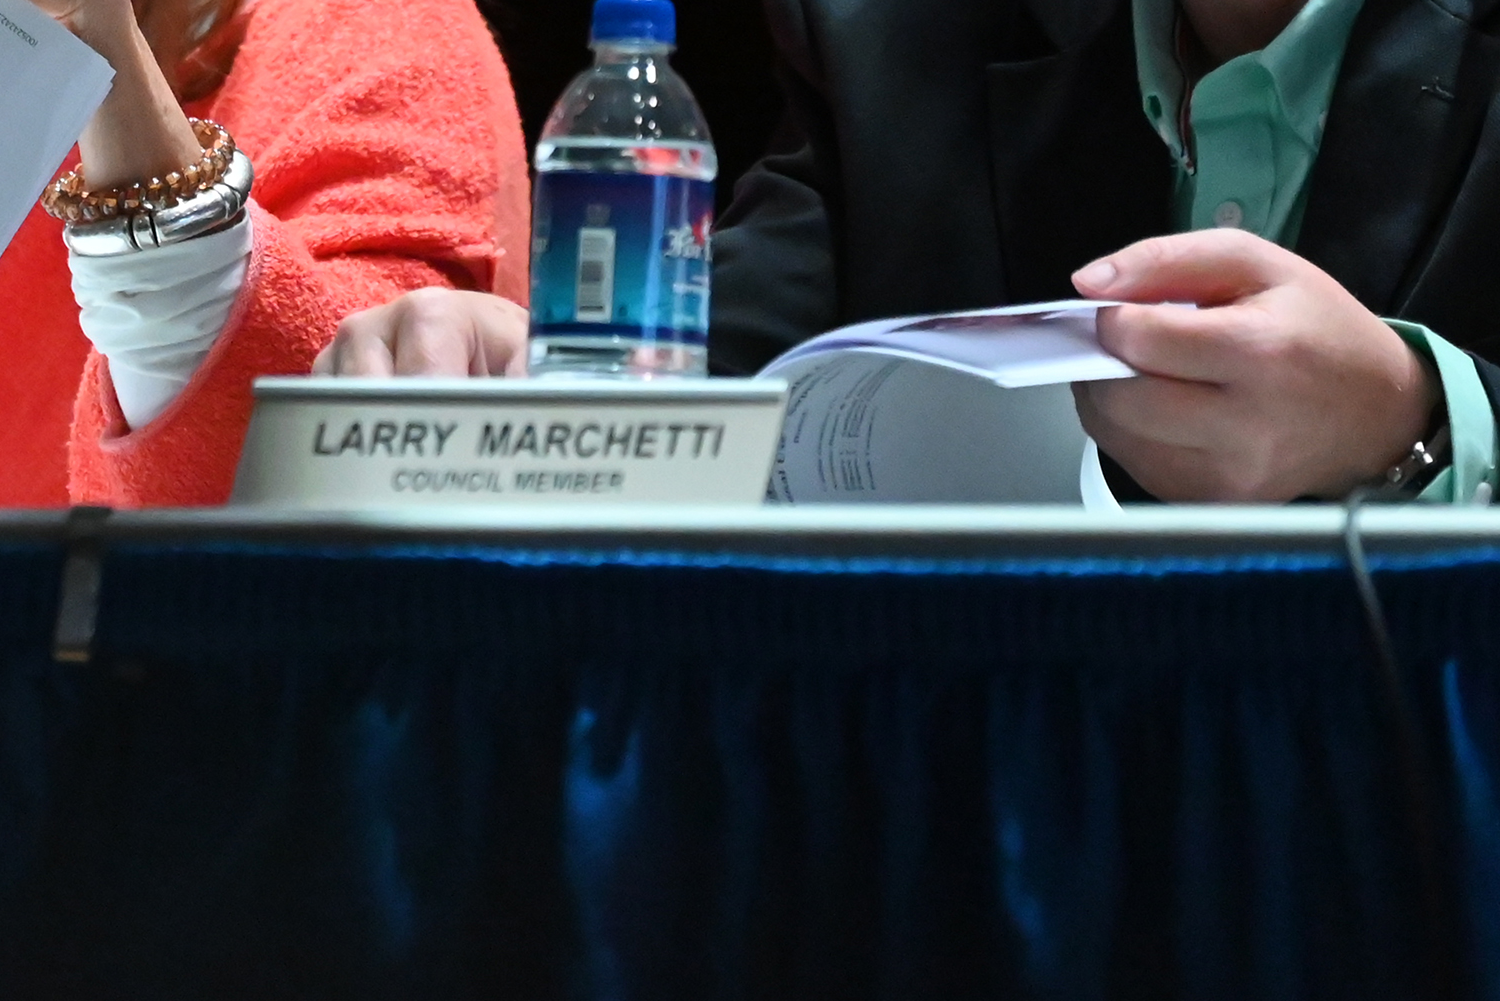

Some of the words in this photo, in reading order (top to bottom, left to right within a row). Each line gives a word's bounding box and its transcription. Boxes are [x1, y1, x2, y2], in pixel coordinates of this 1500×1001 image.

[313, 422, 457, 456] LARRY
[477, 422, 725, 458] MARCHETTI
[393, 470, 503, 493] COUNCIL
[515, 471, 624, 493] MEMBER
